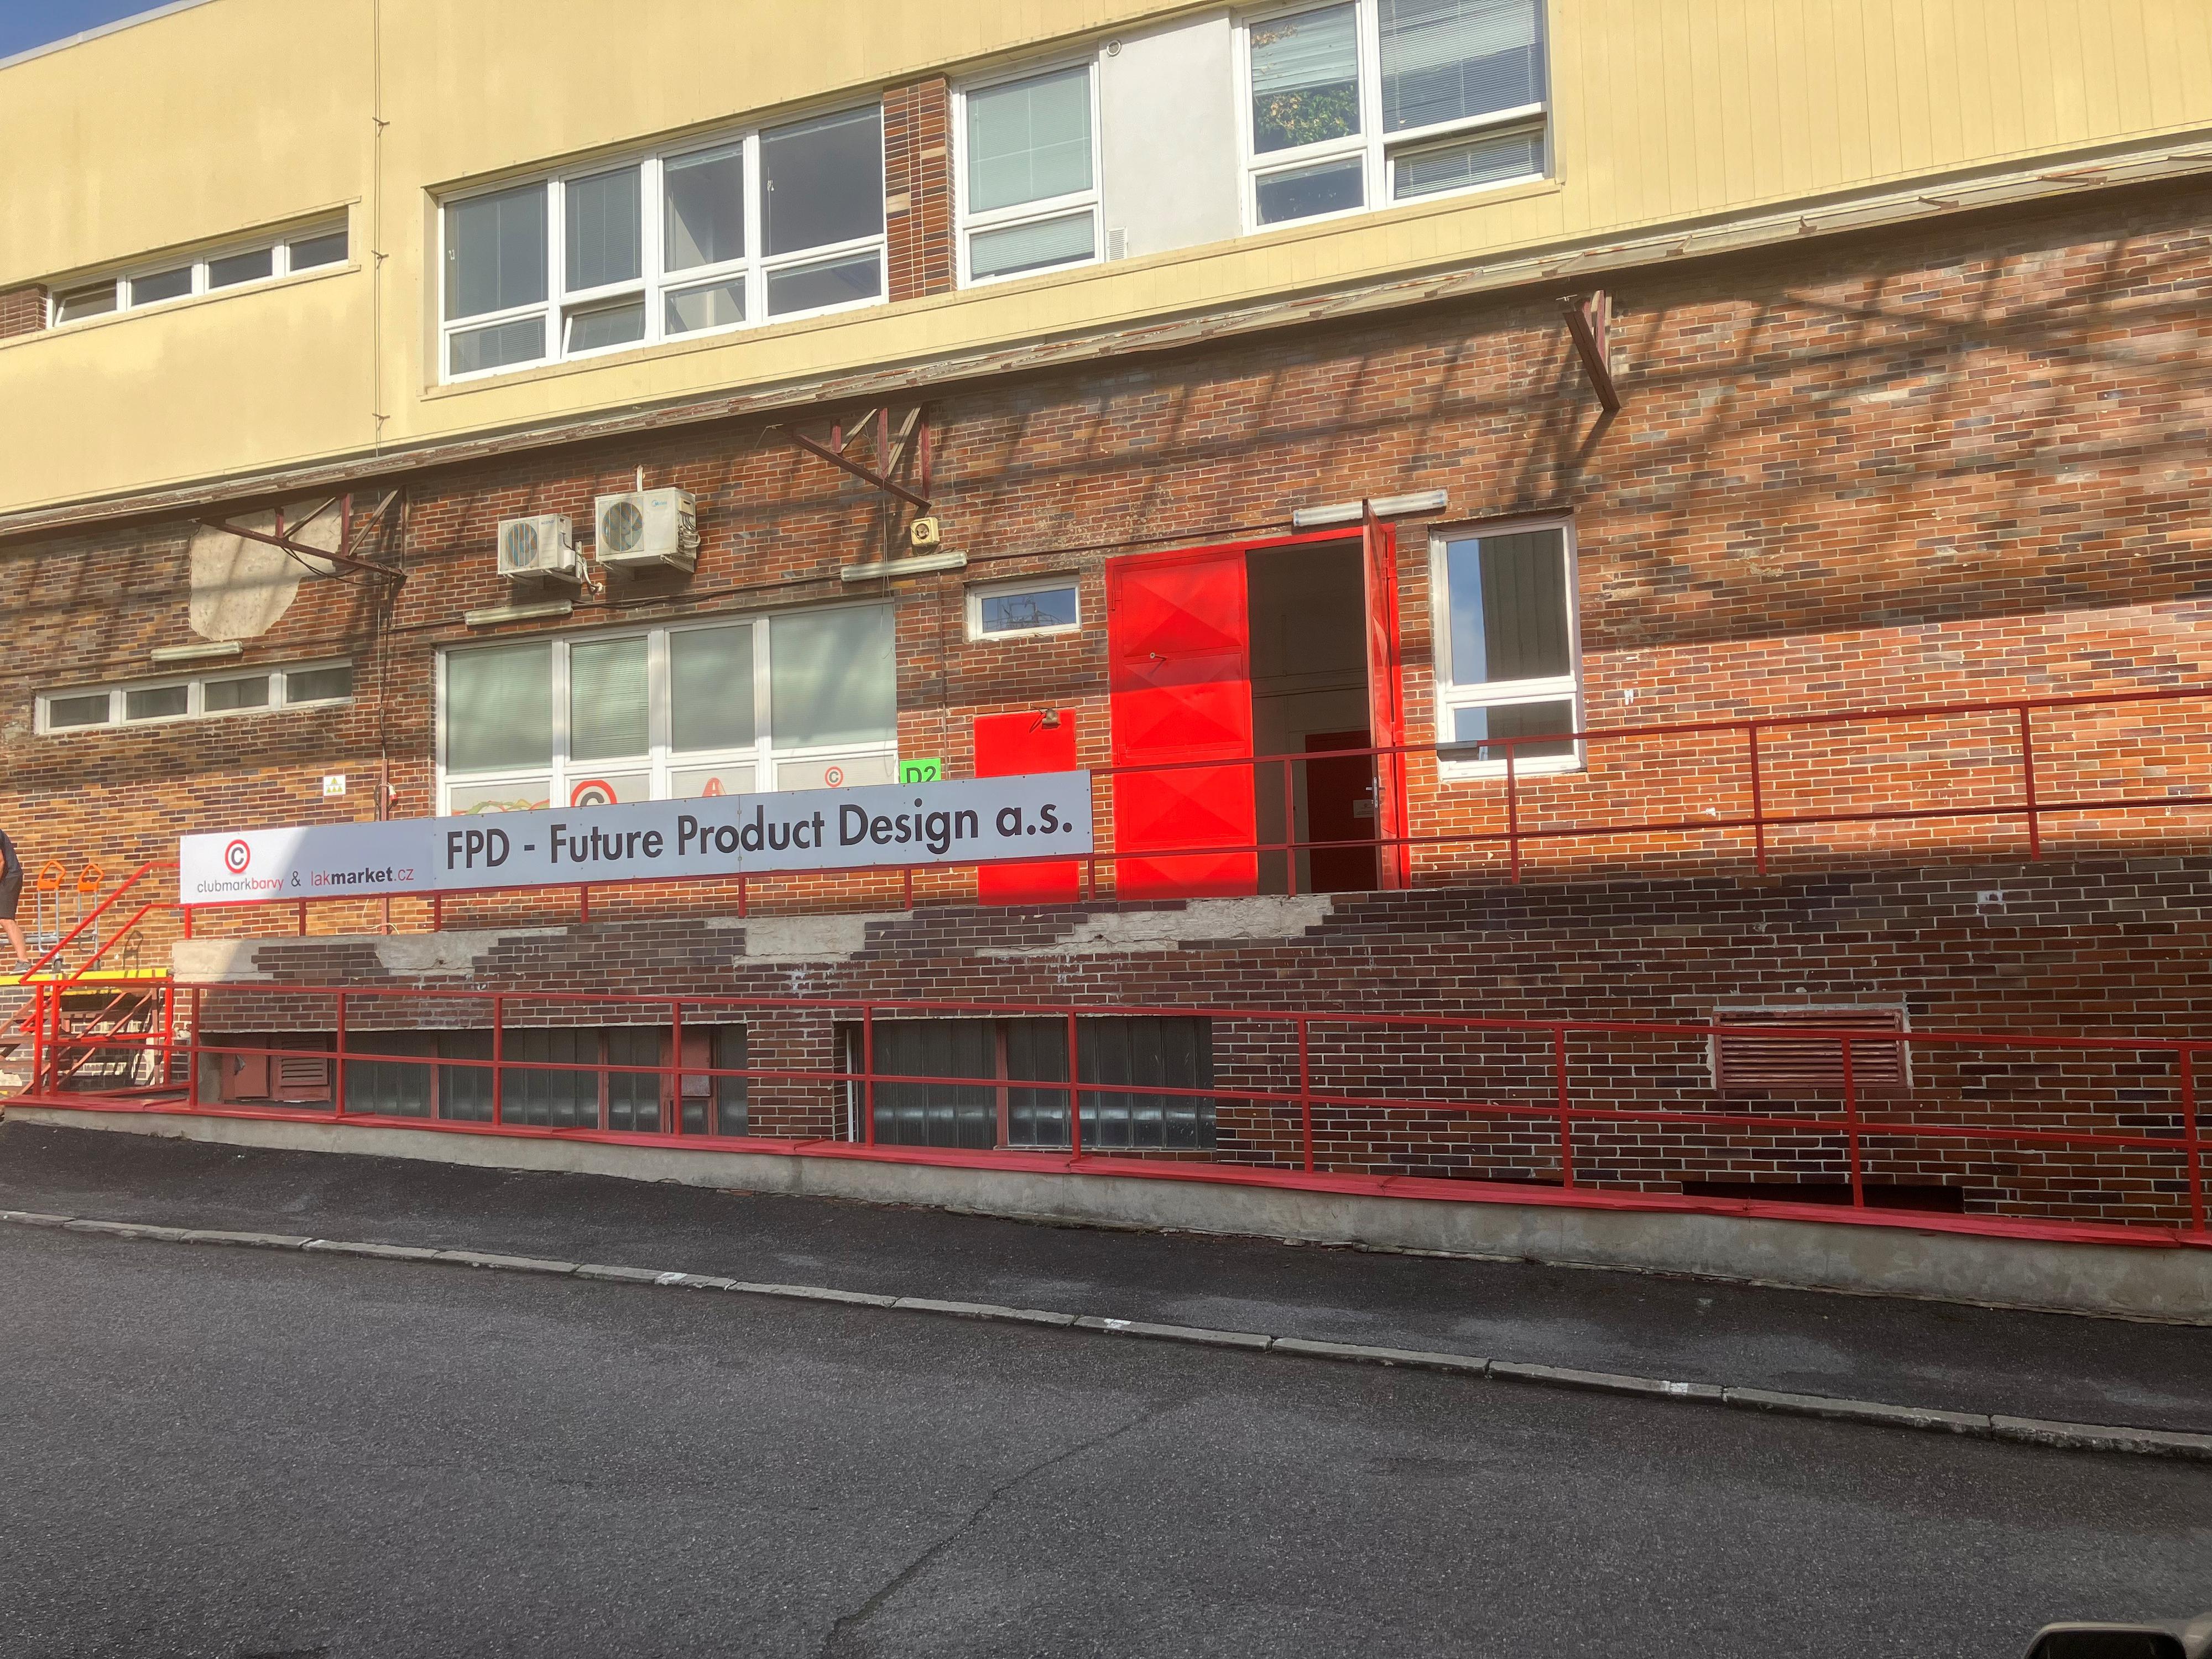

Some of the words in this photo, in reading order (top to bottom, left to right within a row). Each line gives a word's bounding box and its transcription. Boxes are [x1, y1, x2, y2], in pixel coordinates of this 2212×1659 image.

[906, 766, 936, 783] D2
[447, 828, 510, 869] FPD
[550, 824, 663, 863] Future
[678, 805, 825, 855] Product
[839, 798, 978, 854] Design
[996, 804, 1072, 837] a.s.
[291, 870, 301, 887] &
[311, 867, 414, 886] lakmarket.cz
